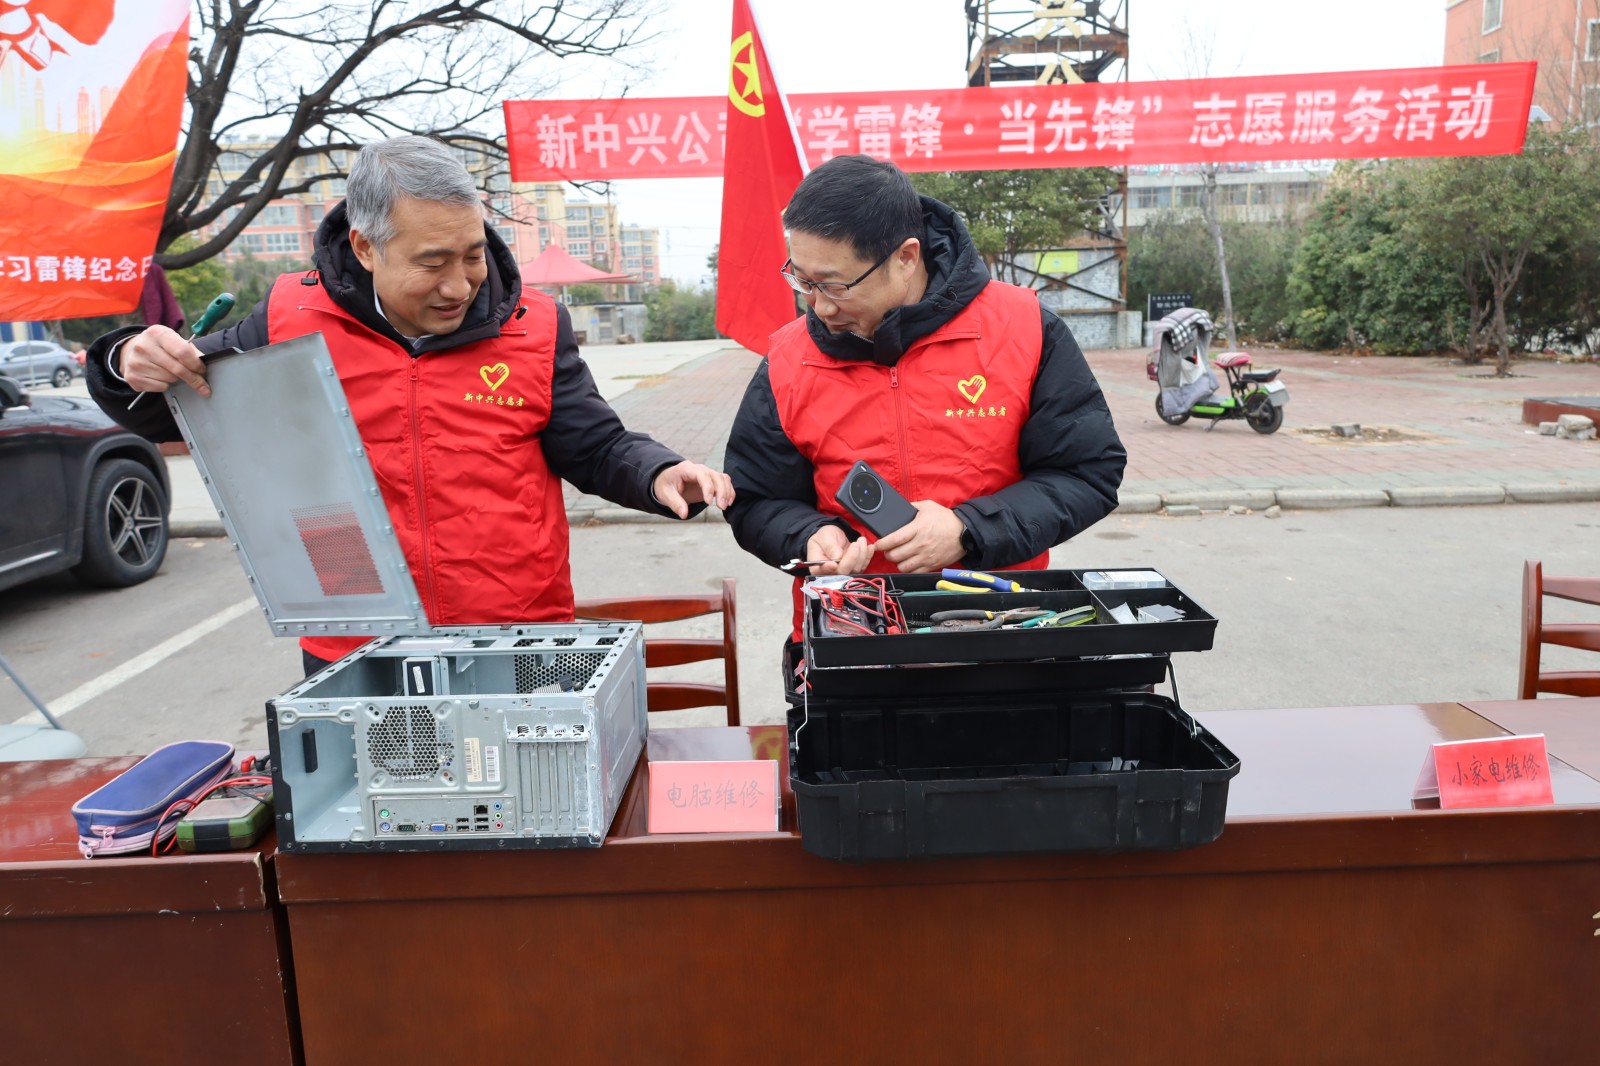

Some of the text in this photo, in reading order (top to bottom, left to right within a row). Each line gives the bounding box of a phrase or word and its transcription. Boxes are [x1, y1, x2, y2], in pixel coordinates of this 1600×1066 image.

[0, 255, 153, 282] 习雷锋纪念日
[463, 391, 524, 407] 新中兴志愿者
[1452, 753, 1540, 787] 小家电维修
[667, 779, 764, 811] 电脑维修
